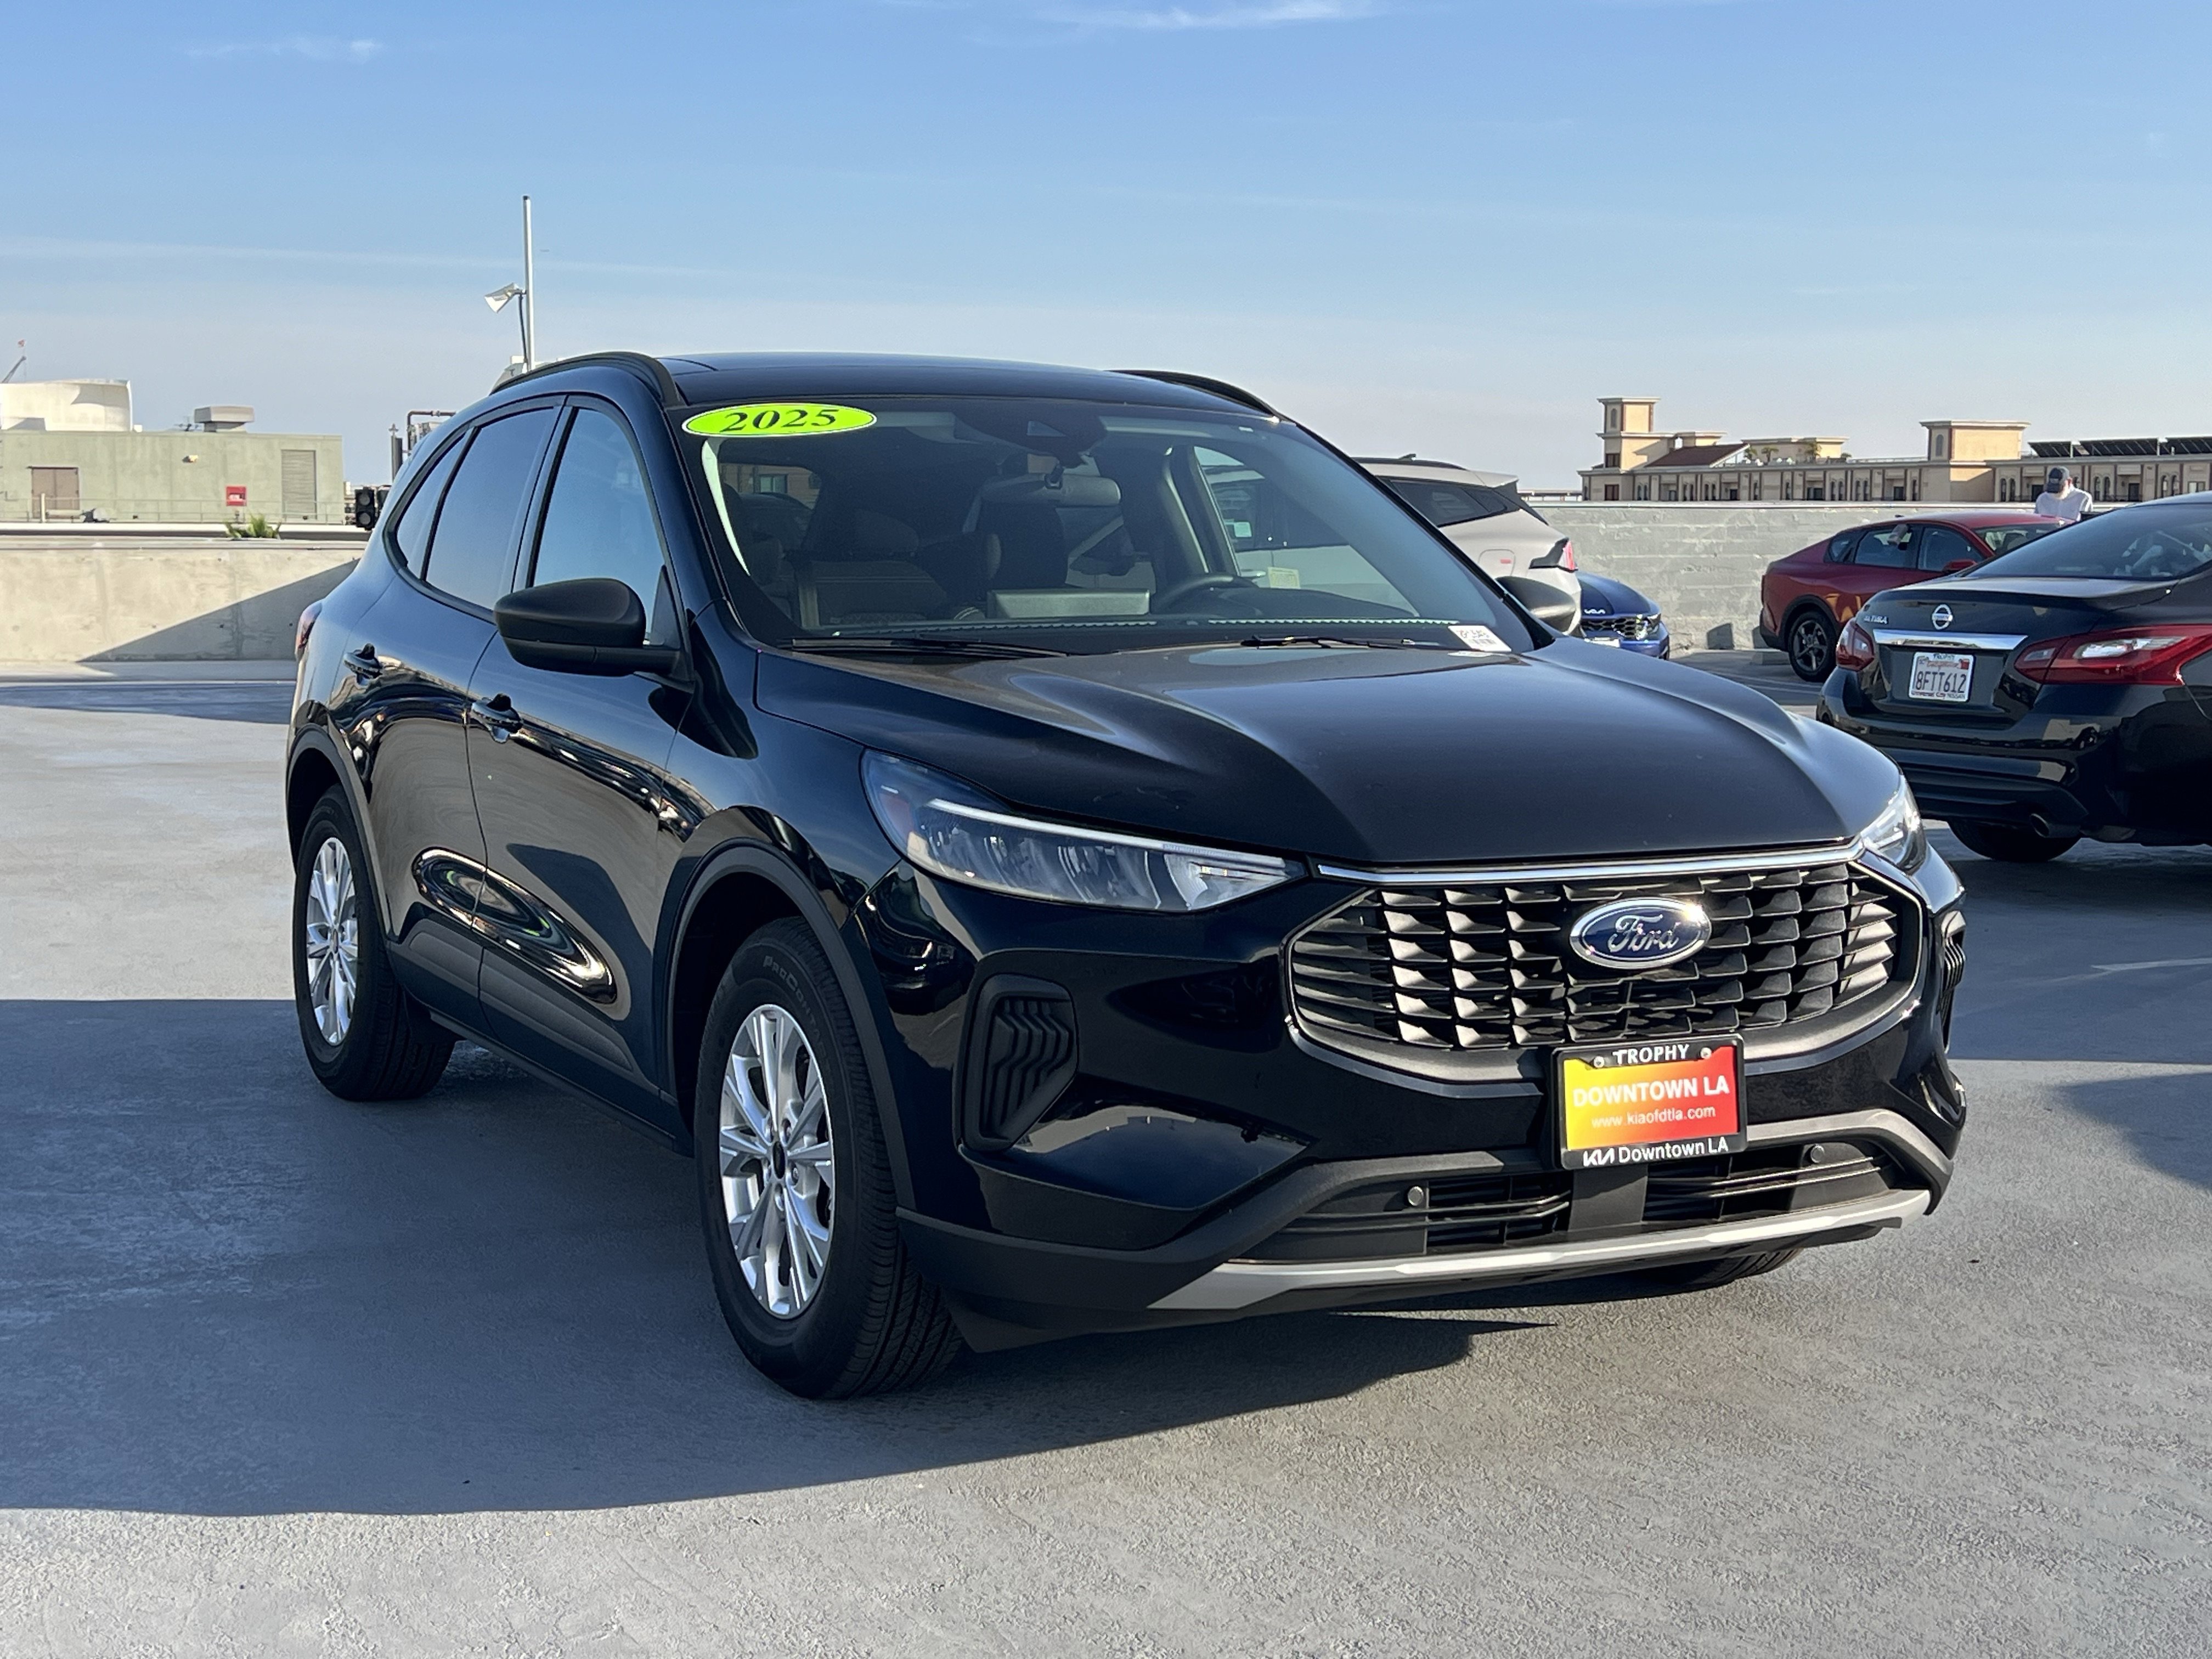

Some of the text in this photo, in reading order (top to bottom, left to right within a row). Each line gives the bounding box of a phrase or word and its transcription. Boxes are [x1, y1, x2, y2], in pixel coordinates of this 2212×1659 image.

[719, 409, 840, 432] 2025
[1915, 671, 1967, 693] 8FTT612
[1608, 915, 1680, 952] Ford
[1612, 1044, 1689, 1065] TROPHY
[1573, 1075, 1729, 1107] DOWNTOWN LA
[1618, 1141, 1705, 1163] Downtown
[1708, 1136, 1729, 1153] LA
